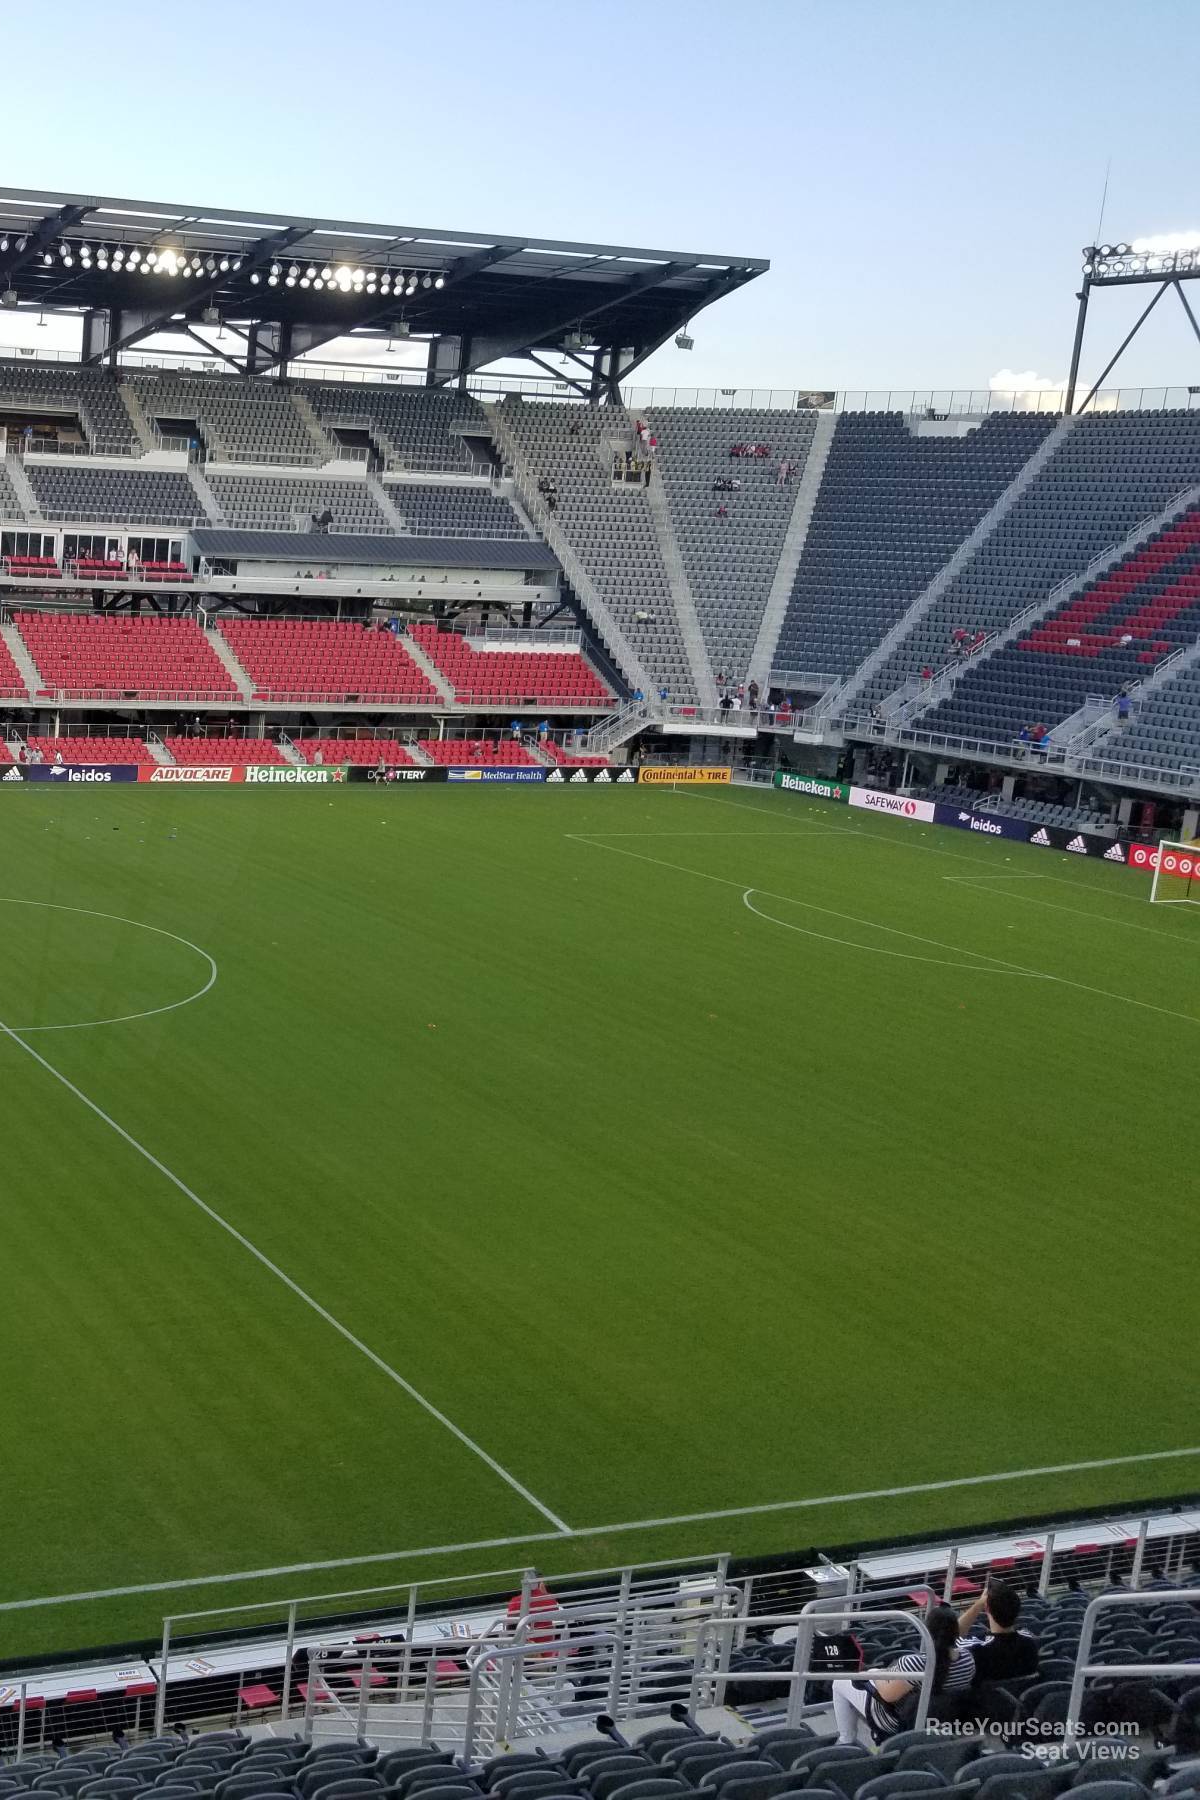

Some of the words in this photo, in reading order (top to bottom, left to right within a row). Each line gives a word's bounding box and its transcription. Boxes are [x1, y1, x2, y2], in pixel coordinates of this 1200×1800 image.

[68, 769, 112, 782] leidos
[151, 767, 232, 782] ADVOCARE
[245, 766, 328, 783] Heineken
[394, 770, 426, 780] TTERY
[482, 768, 518, 780] MedStar
[520, 768, 542, 780] Health
[642, 769, 696, 782] Continental
[708, 772, 728, 780] TIRE
[781, 774, 831, 797] Heineken
[865, 794, 904, 811] SAFEWAY
[970, 817, 1002, 834] leidos
[1030, 836, 1051, 846] adidas
[1066, 844, 1087, 854] adidas
[1103, 852, 1125, 863] adidas
[312, 1649, 328, 1659] 28
[824, 1645, 839, 1656] 128
